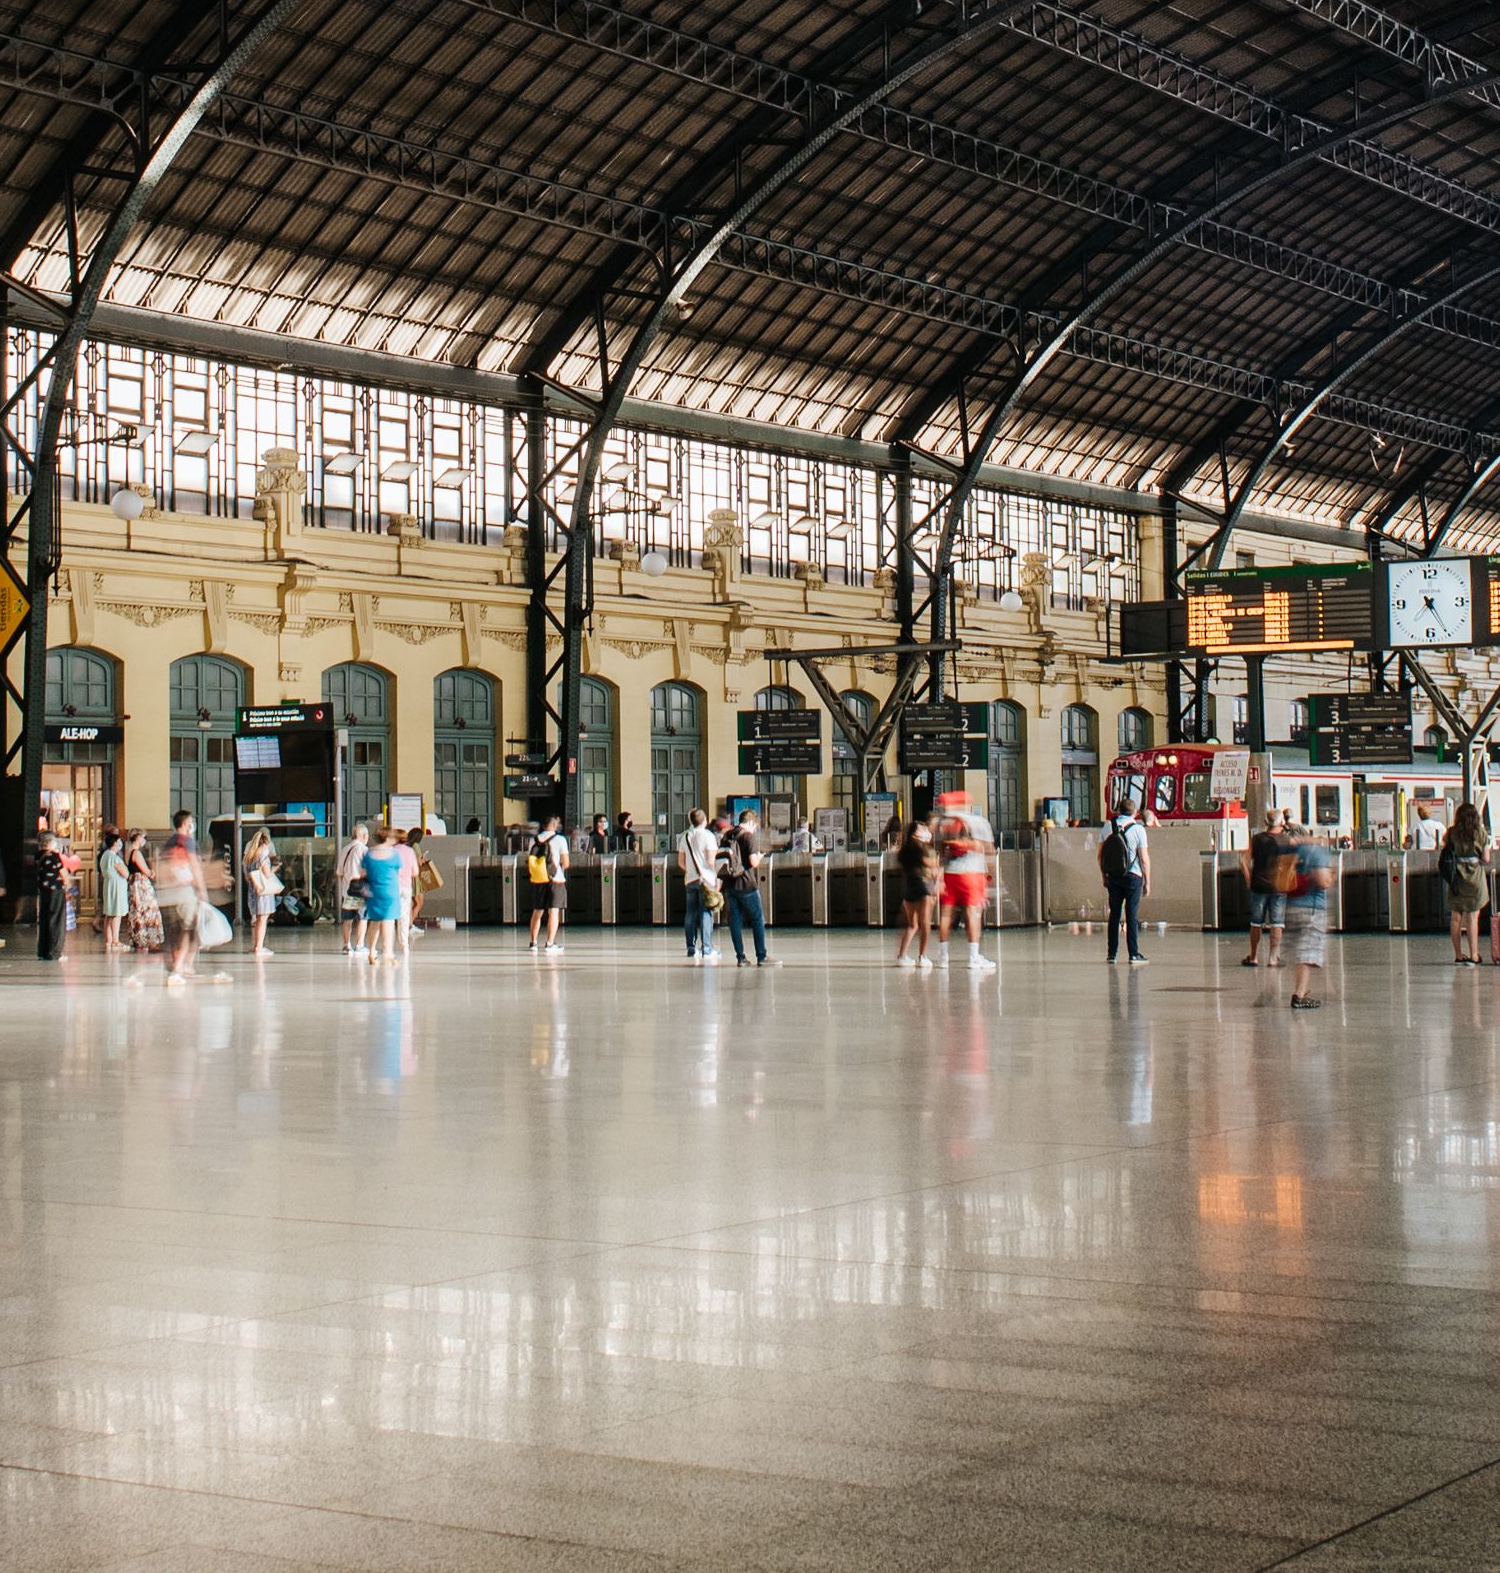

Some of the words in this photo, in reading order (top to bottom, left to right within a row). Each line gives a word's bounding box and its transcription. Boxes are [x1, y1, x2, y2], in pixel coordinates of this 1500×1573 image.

[1422, 568, 1438, 580] 12
[1396, 599, 1406, 610] 9
[1454, 596, 1464, 607] 3
[0, 587, 7, 632] tiendas
[1426, 628, 1436, 638] 6
[1331, 711, 1340, 724] 3
[961, 718, 968, 731] 2
[60, 728, 99, 740] ALE-HOP
[754, 726, 762, 738] 1
[962, 754, 969, 767] 2
[1332, 750, 1340, 763] 3
[755, 761, 762, 772] 1
